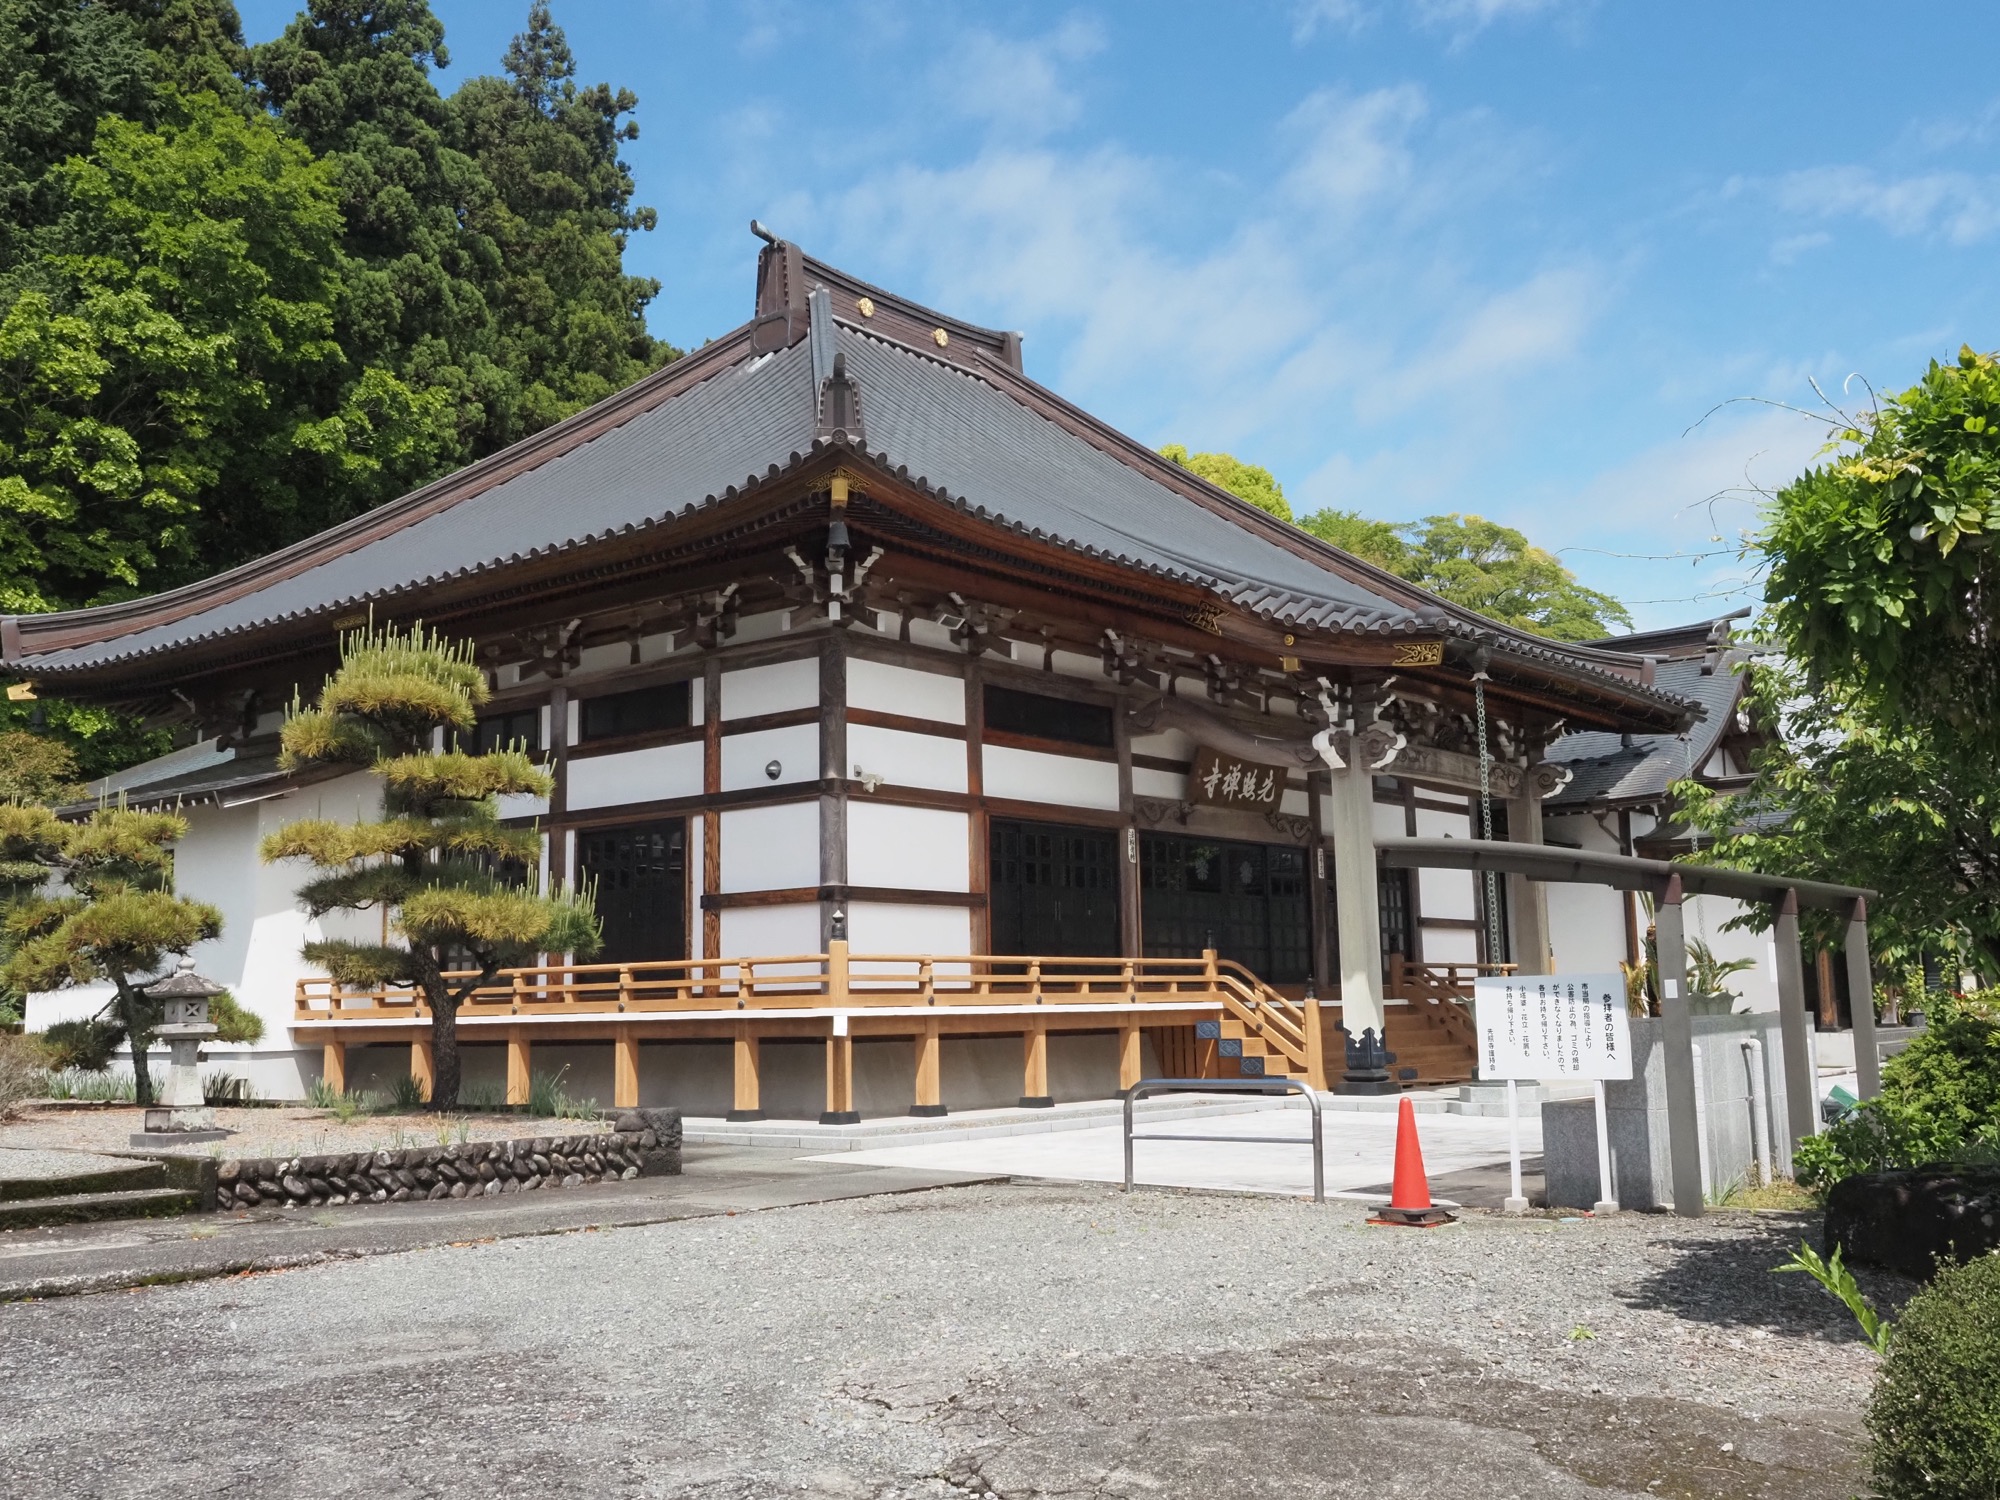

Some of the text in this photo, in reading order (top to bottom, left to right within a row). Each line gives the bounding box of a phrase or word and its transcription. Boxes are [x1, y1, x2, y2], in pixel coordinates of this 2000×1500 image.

[1505, 985, 1516, 1046] お持ち帰り下さい。
[1538, 984, 1550, 1060] 各自お持ち帰り下さい。
[1552, 983, 1566, 1074] ができなくなりましたので、
[1581, 983, 1592, 1049] 市当局の指導により
[1602, 993, 1616, 1060] 参拝者の皆様へ
